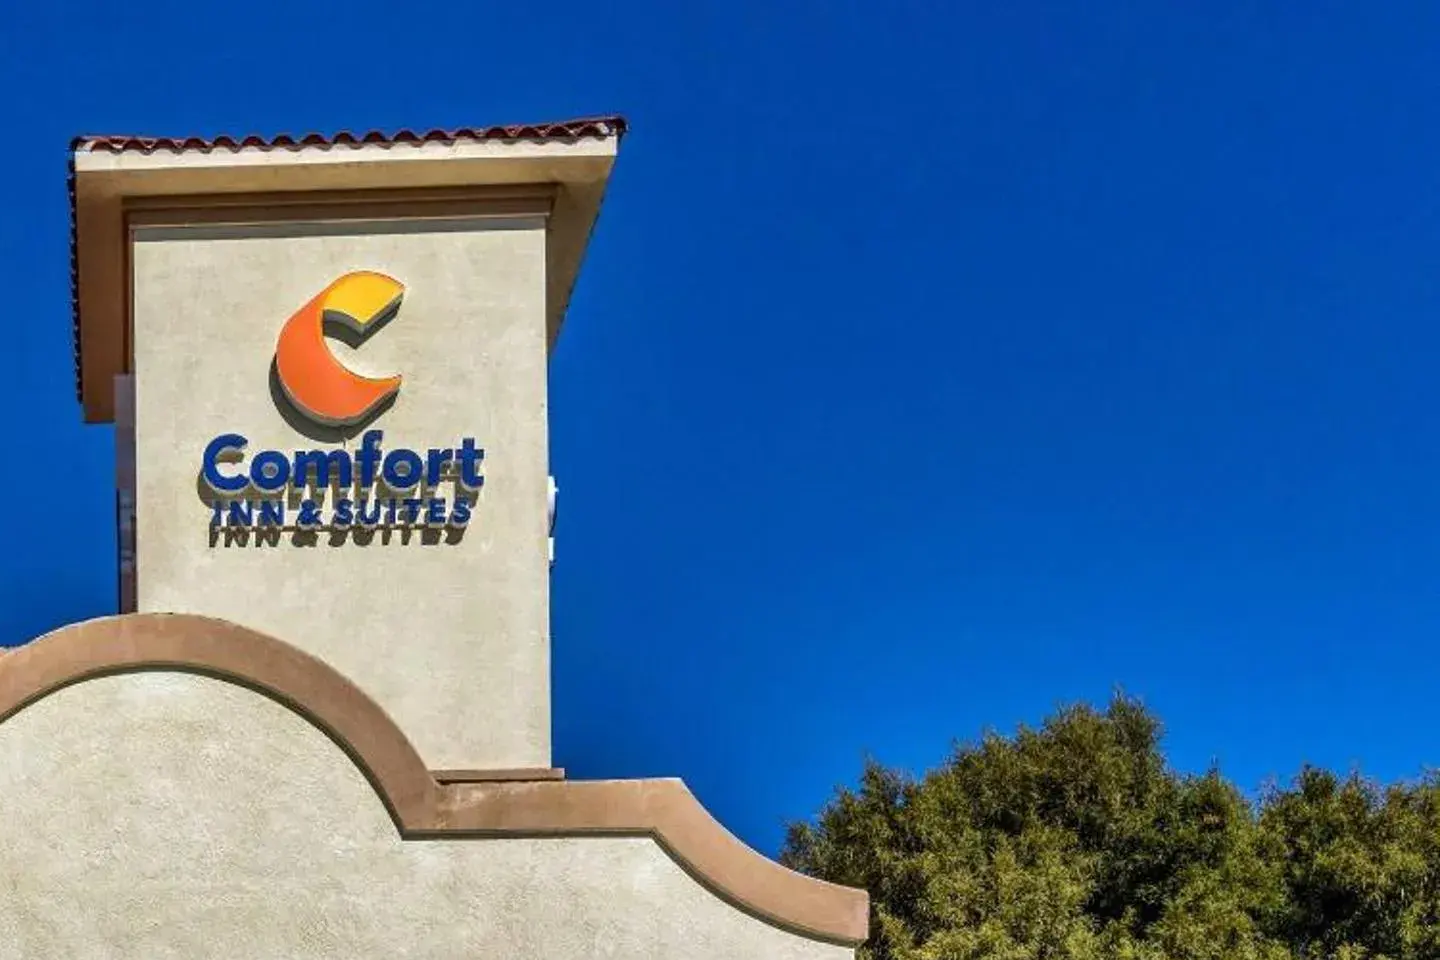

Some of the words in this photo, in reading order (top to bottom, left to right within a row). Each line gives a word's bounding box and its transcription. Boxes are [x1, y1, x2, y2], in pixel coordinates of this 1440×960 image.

[203, 429, 485, 491] Comfort
[212, 499, 284, 526] INN
[297, 499, 322, 526] &
[334, 497, 471, 525] SUITES
